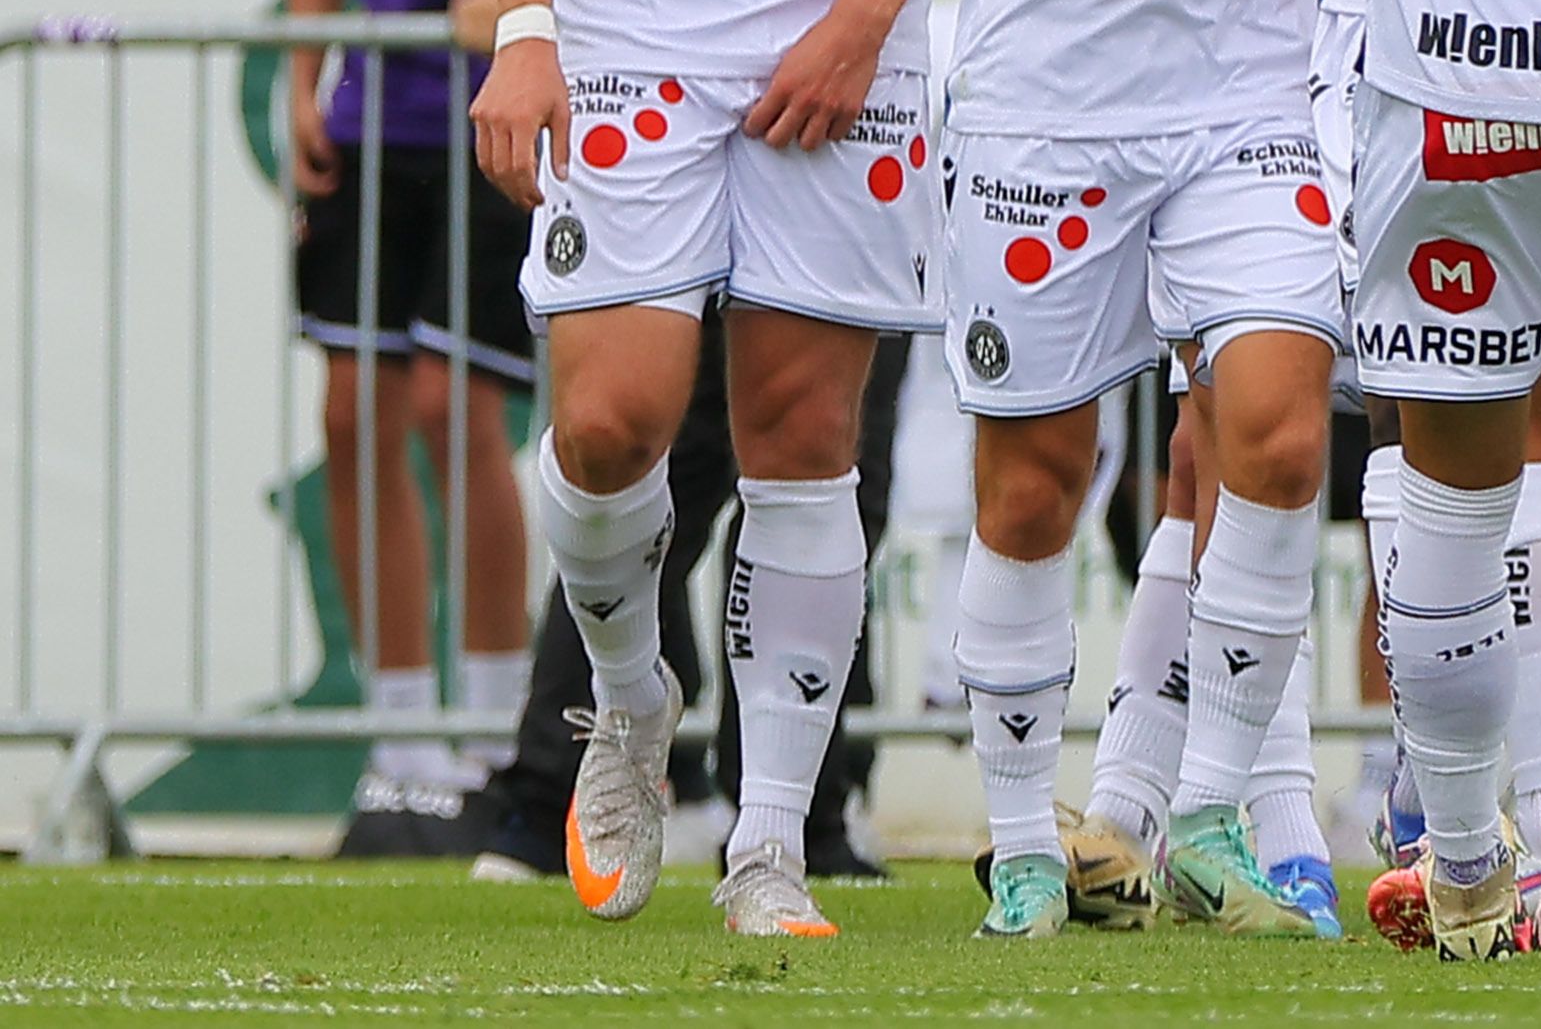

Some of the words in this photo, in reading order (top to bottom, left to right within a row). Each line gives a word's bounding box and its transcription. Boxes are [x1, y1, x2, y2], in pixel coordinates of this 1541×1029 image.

[970, 176, 1069, 209] Schuller
[984, 204, 1050, 229] Eh'klar
[1430, 258, 1474, 294] M
